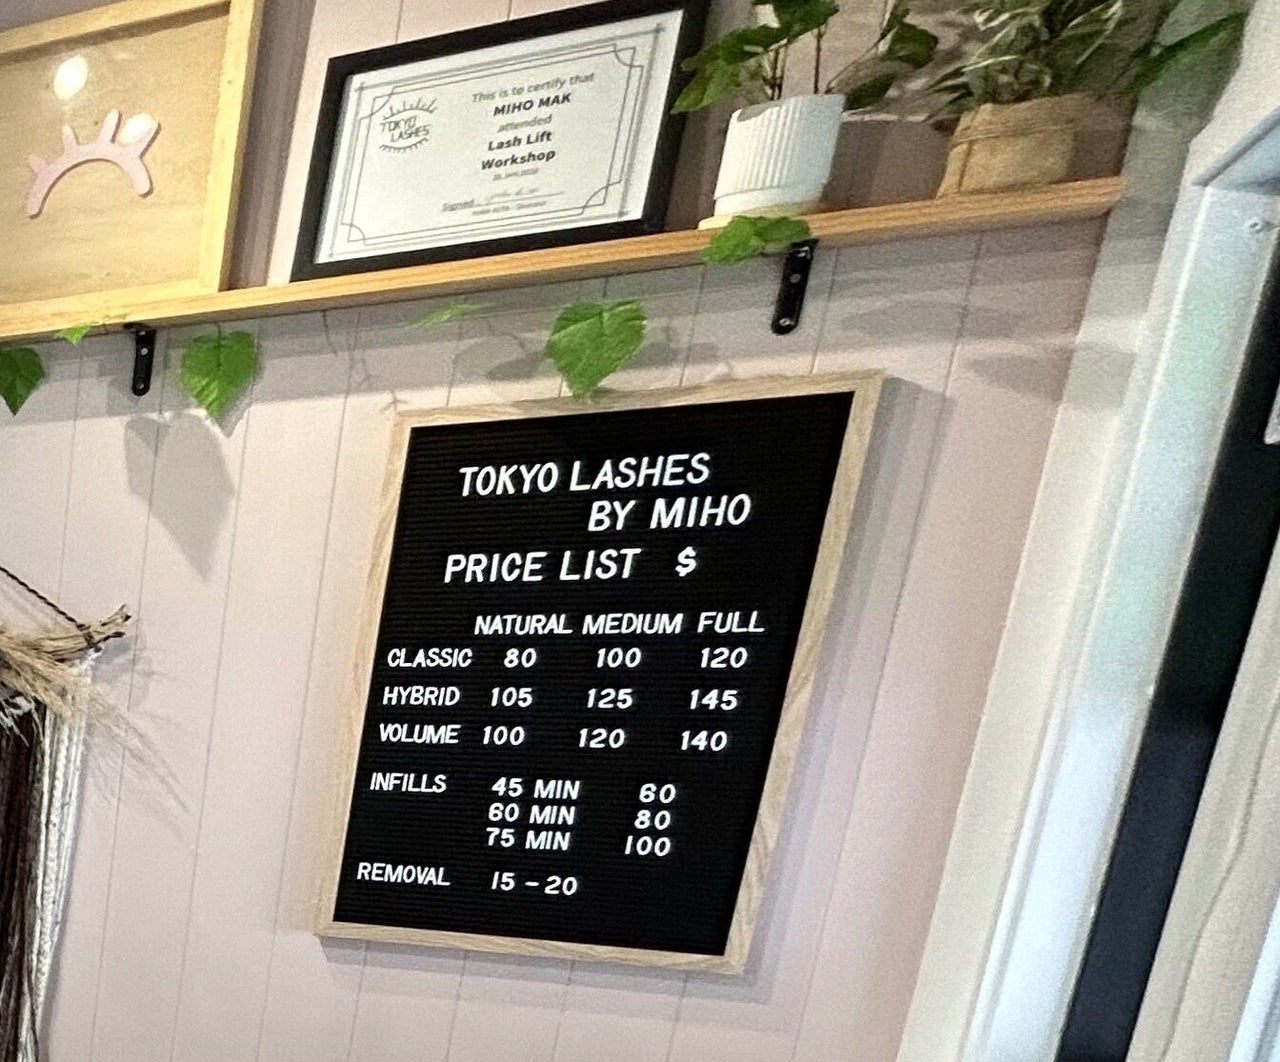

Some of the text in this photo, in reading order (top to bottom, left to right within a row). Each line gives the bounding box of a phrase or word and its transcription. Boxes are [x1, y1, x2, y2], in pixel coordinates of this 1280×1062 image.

[499, 86, 509, 98] is
[512, 85, 525, 97] to
[526, 77, 567, 94] certify
[493, 92, 572, 117] MIHO MAK
[497, 114, 553, 133] attended
[488, 130, 553, 151] Lash Lift
[481, 150, 556, 170] Workshop
[459, 452, 711, 497] TOKYO LASHES
[587, 493, 752, 532] BY MIHO
[444, 546, 697, 584] PRICE LIST $
[473, 610, 765, 636] NATURAL MEDIUM FULL
[387, 646, 748, 669] CLASSIC 80 100 120
[382, 685, 738, 711] HYBRID 105 125 145
[379, 722, 728, 752] VOLUME 100 120 140
[369, 772, 677, 804] INFILLS 45 MIN 60
[488, 802, 671, 831] 60 MIN 80
[485, 827, 672, 857] 75 MIN 100
[356, 861, 451, 886] REMOVAL
[491, 871, 515, 891] 15
[544, 875, 578, 896] 20
